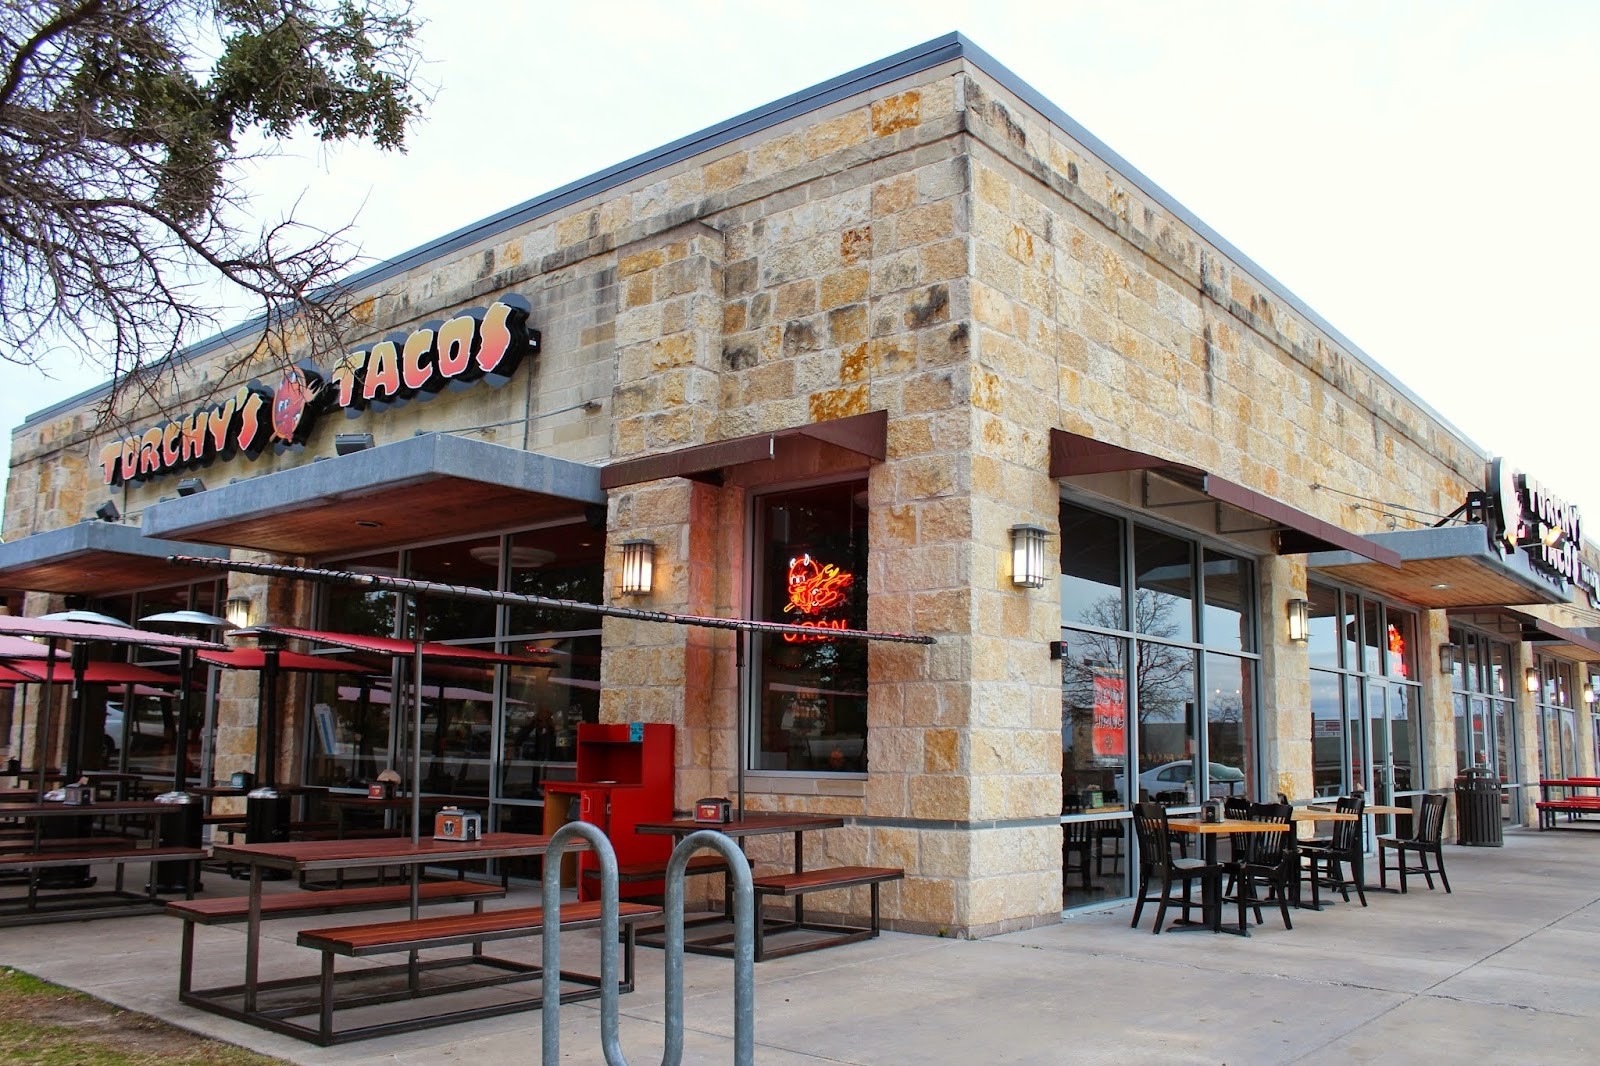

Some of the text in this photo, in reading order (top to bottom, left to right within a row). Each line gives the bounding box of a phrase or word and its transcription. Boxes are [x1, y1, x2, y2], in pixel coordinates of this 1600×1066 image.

[99, 300, 511, 484] TORCHY'S TACOS
[783, 619, 847, 642] OPEN
